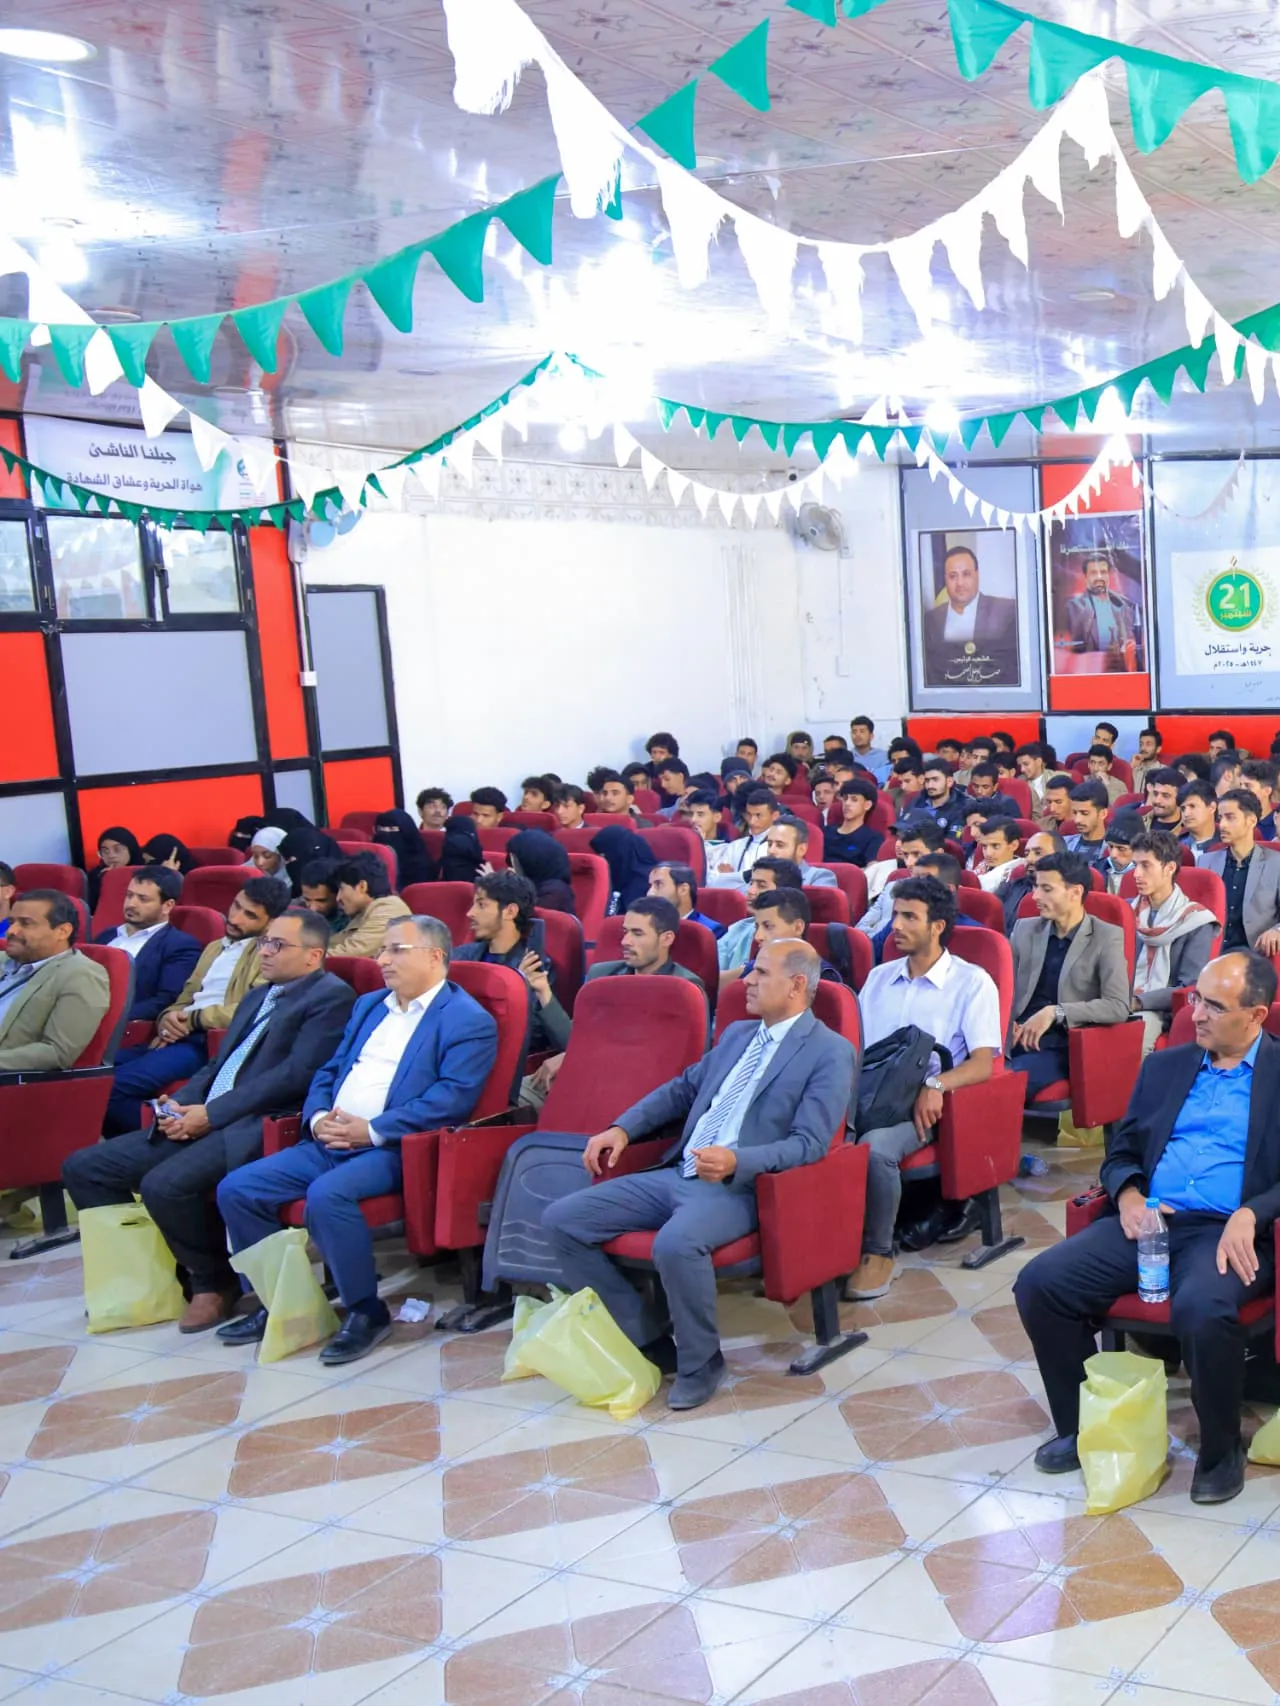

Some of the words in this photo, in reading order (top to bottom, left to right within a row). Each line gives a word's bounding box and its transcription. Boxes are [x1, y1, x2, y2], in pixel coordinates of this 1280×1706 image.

[140, 444, 177, 464] جيلنا
[66, 472, 110, 486] الشهادة
[150, 478, 179, 493] الحرية
[181, 479, 203, 493] هواة
[1219, 582, 1251, 609] 21
[1219, 609, 1252, 619] سبتمبر
[1204, 643, 1247, 656] واستقلال
[1249, 643, 1272, 657] حرية
